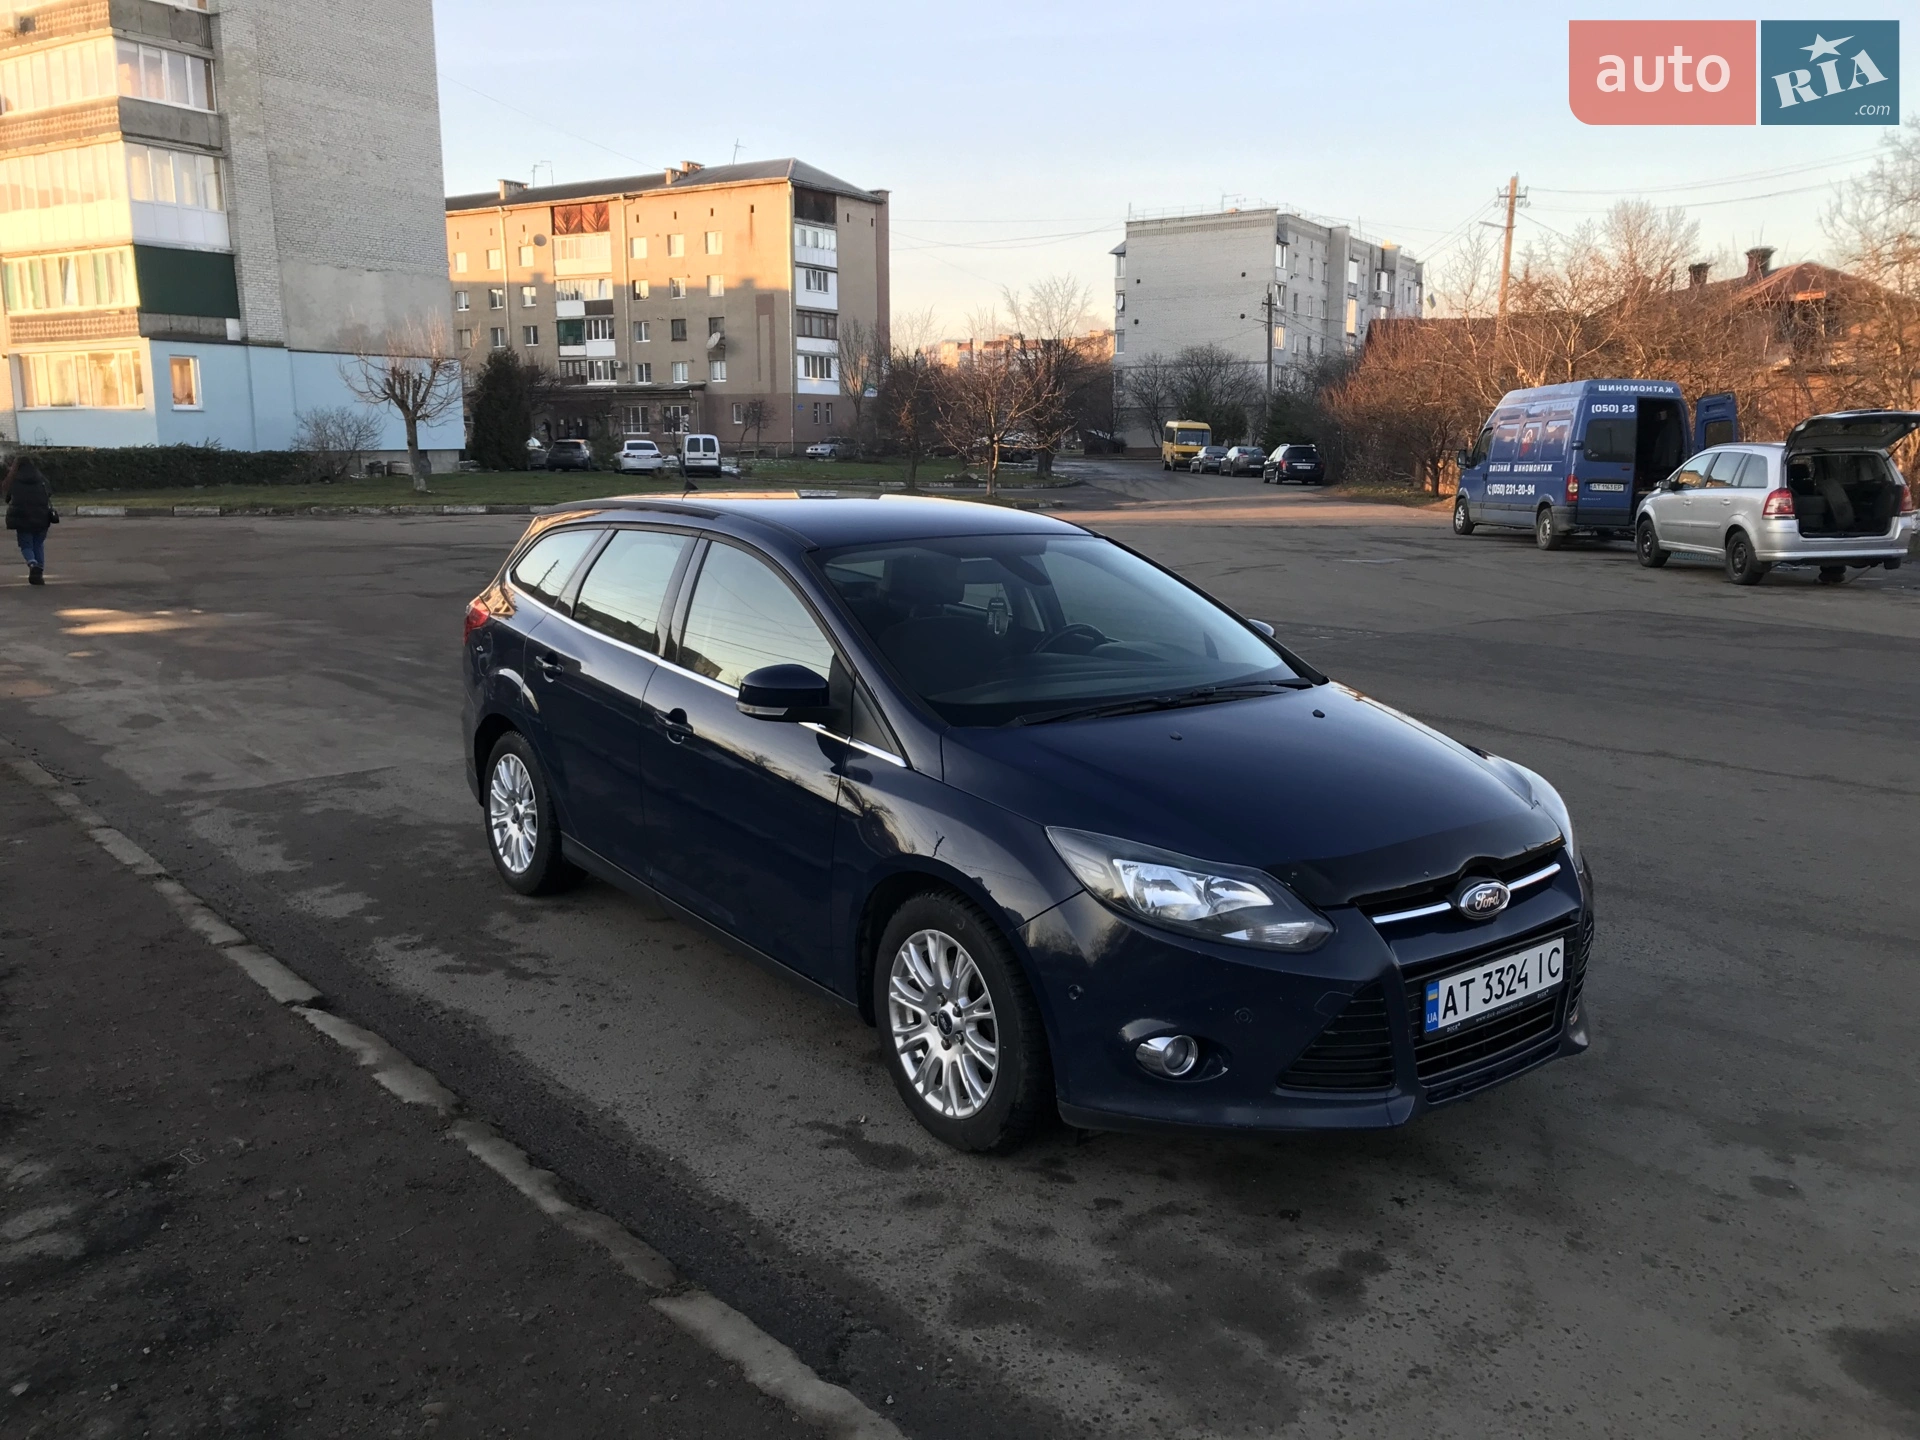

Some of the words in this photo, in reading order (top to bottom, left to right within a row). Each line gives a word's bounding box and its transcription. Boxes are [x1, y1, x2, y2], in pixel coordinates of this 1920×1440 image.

[1598, 384, 1674, 394] ШИНОМОНТАЖ
[1591, 404, 1619, 413] (050)
[1621, 404, 1636, 413] 23
[1513, 464, 1553, 472] ШИНОМОНТАЖ
[1491, 483, 1506, 496] (050)
[1505, 483, 1535, 496] 231-20-94
[1475, 889, 1500, 911] Ford
[1442, 977, 1476, 1019] AT
[1481, 958, 1528, 1005] 3324
[1538, 947, 1561, 984] IC
[1427, 1012, 1438, 1024] UA
